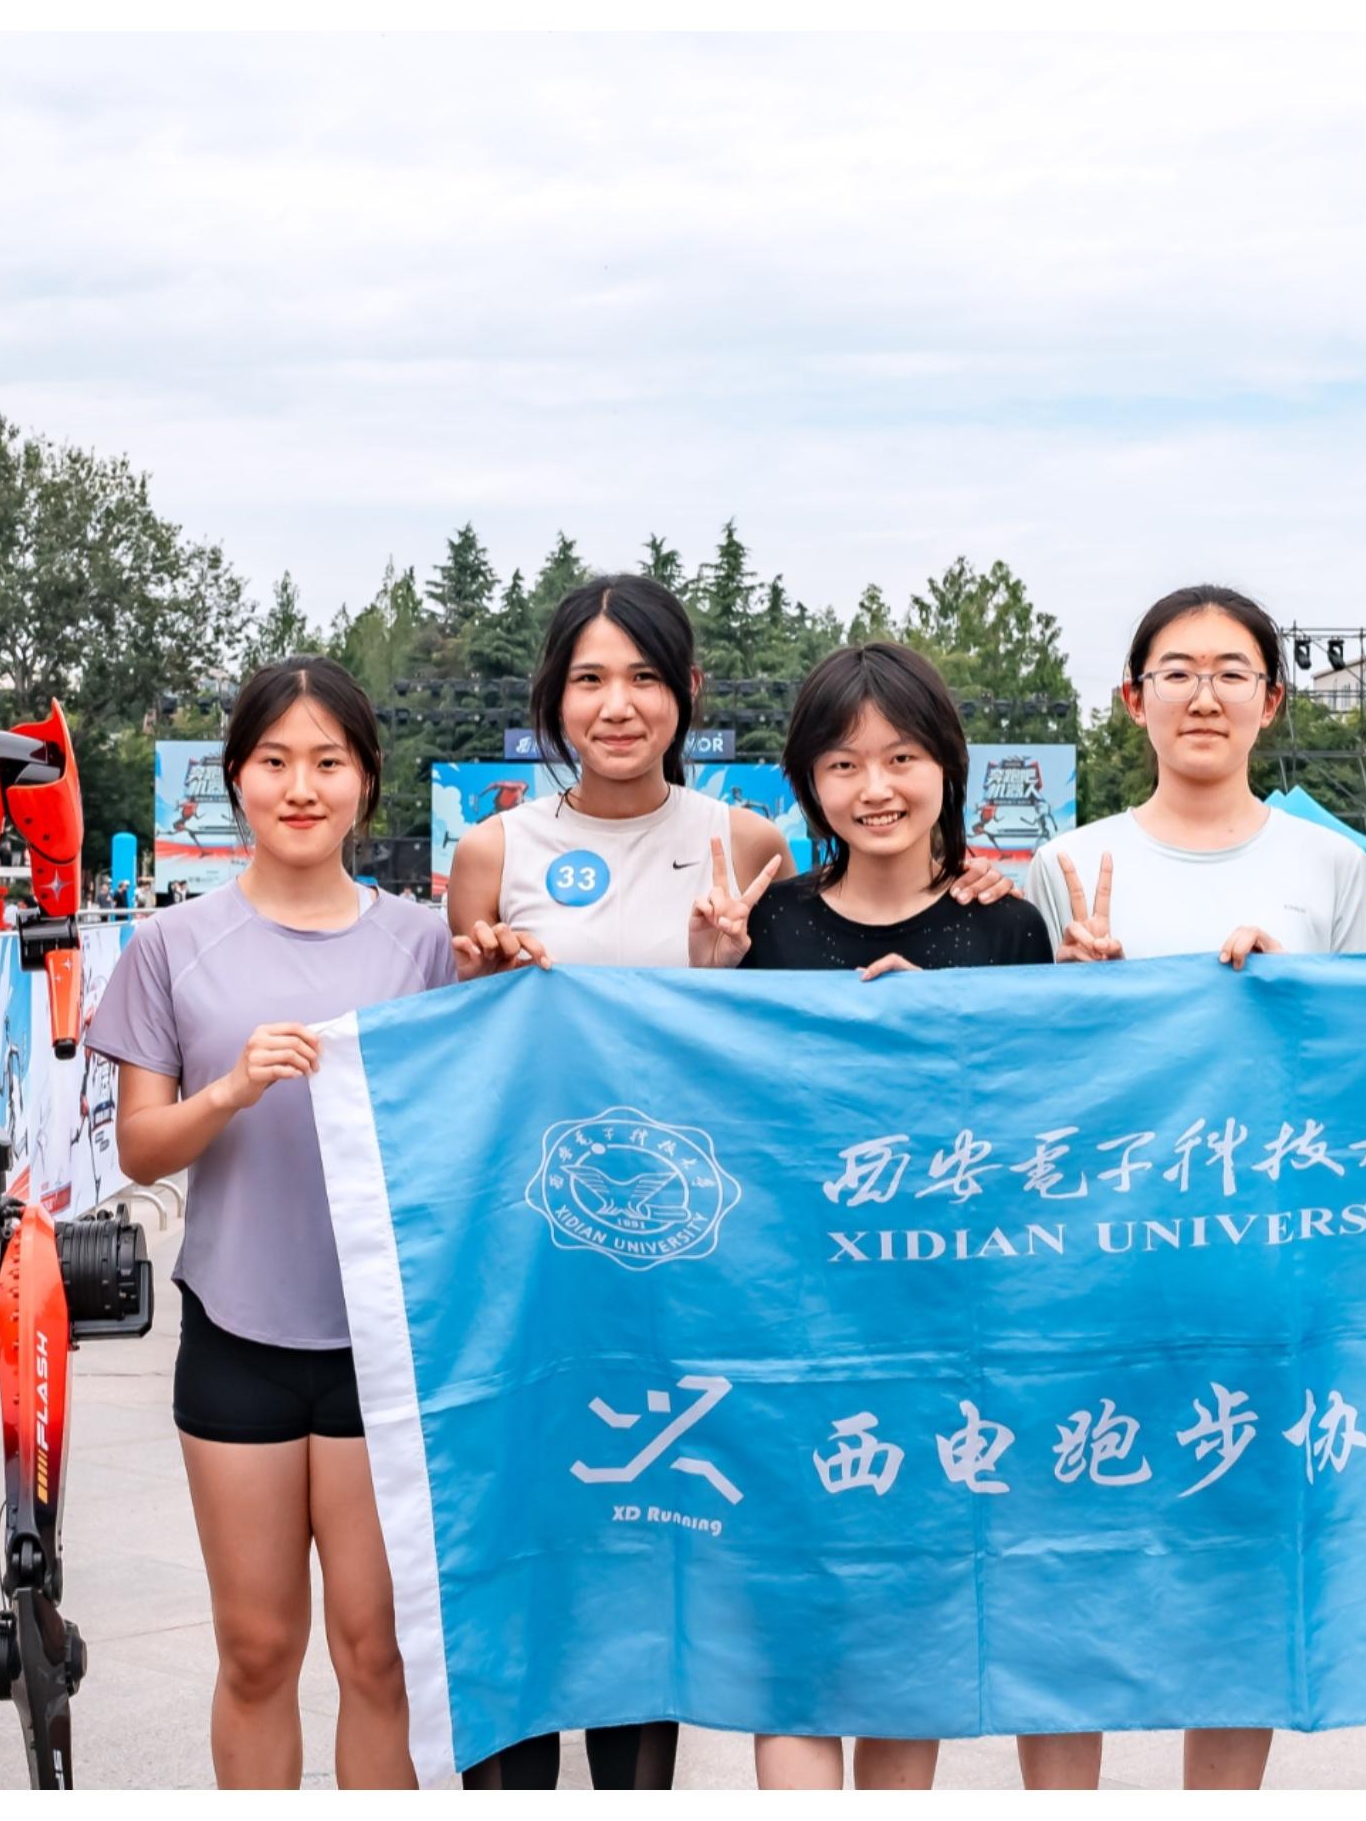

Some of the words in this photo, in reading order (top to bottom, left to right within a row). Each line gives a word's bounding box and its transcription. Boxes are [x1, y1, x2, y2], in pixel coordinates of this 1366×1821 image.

[556, 865, 598, 893] 33
[555, 1204, 607, 1244] XIDIAN
[613, 1211, 709, 1254] UNIVERSITY
[827, 1222, 1067, 1263] XIDIAN
[36, 1332, 49, 1451] FLASH
[612, 1505, 641, 1521] XD
[647, 1506, 723, 1537] Running
